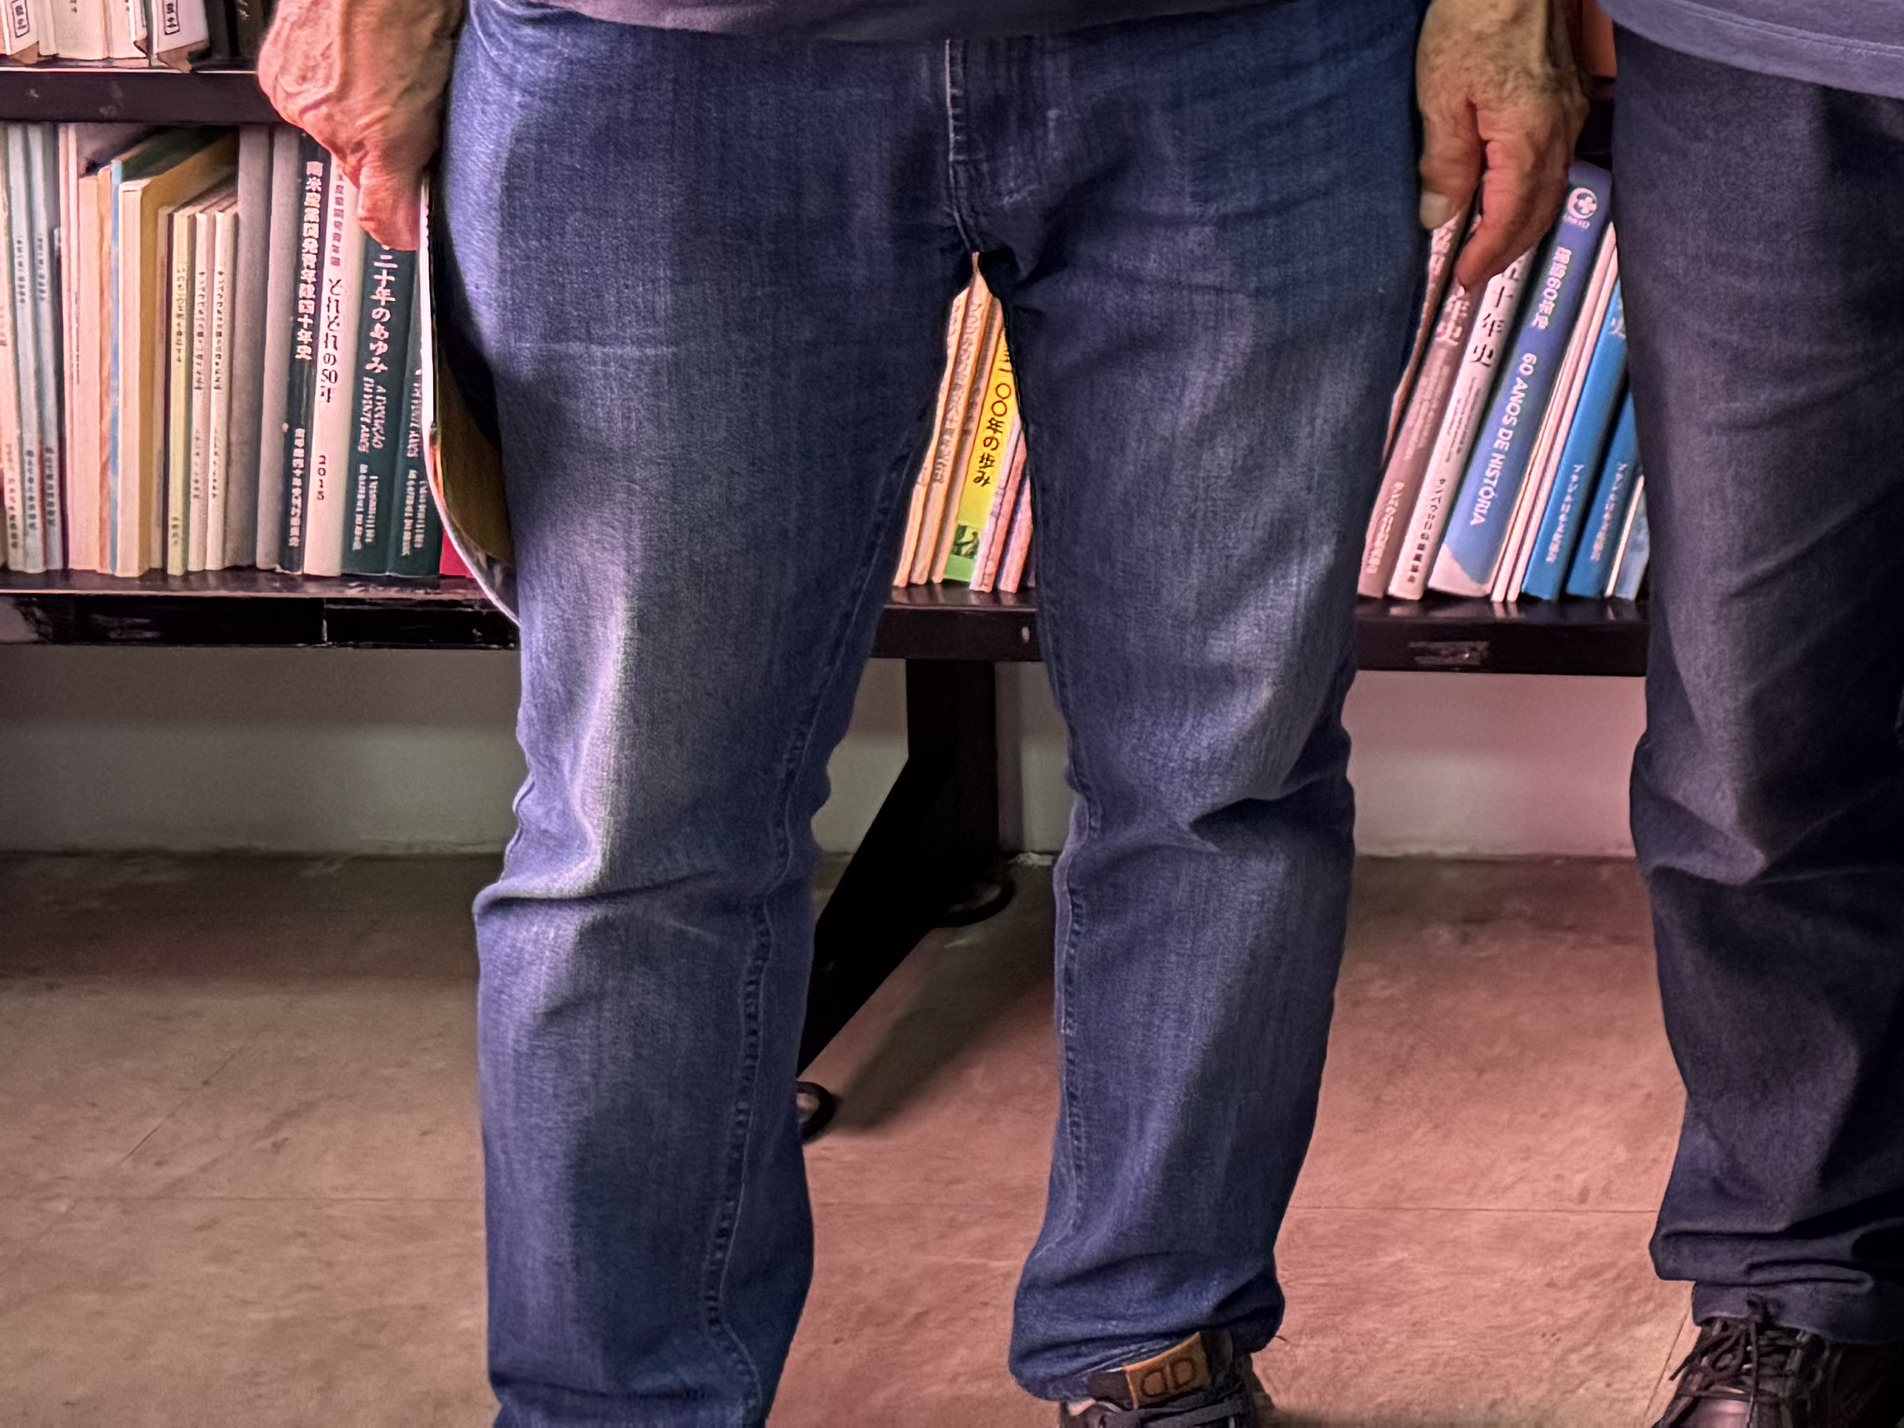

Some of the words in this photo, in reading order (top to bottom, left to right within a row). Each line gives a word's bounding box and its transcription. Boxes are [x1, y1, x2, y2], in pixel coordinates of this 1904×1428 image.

[319, 277, 343, 404] それぞれの50年
[1521, 353, 1539, 377] 60
[1507, 380, 1532, 421] ANOS
[1495, 423, 1514, 452] DE
[315, 454, 327, 502] 2015
[1470, 452, 1507, 528] HISTÓRIA
